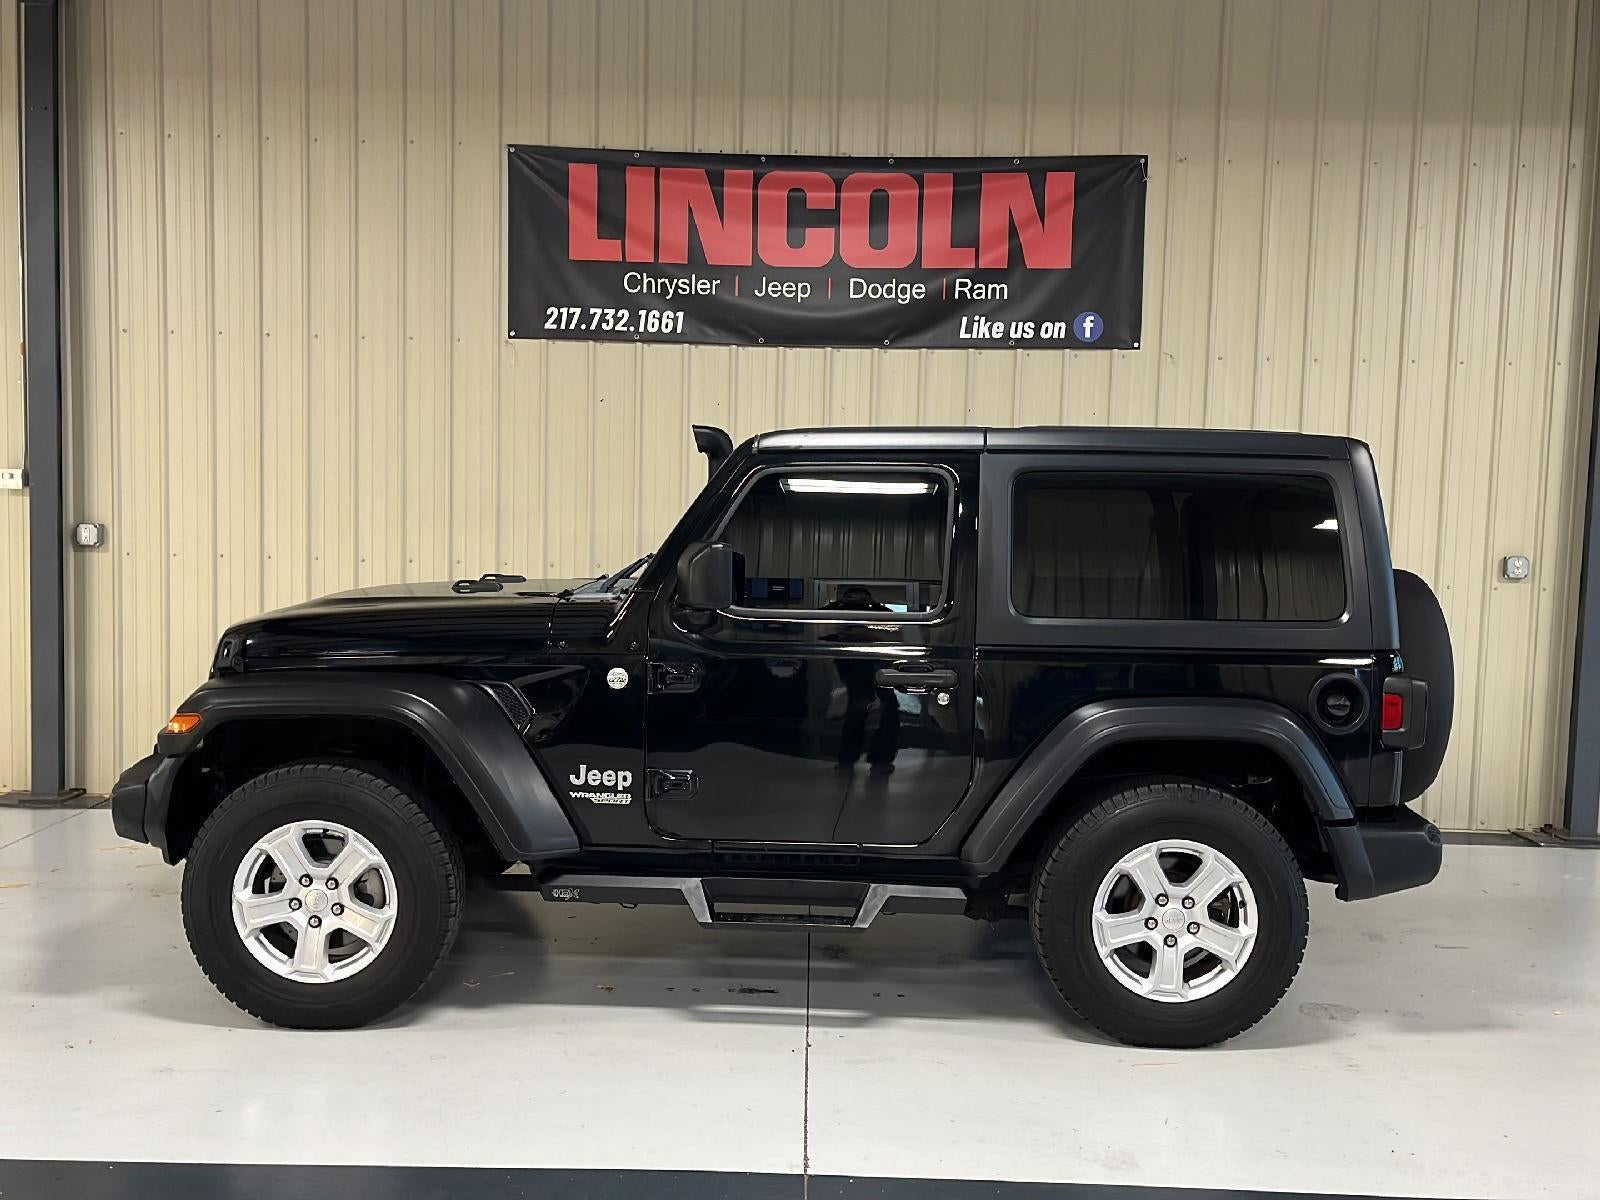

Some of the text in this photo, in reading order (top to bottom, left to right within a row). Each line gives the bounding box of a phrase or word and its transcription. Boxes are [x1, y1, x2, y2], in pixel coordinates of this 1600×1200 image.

[568, 163, 1075, 269] LINCOLN
[623, 271, 1008, 304] Chrysler Jeep Dodge Ram
[543, 306, 684, 333] 217.732.1661
[959, 315, 1004, 339] Like
[1009, 322, 1034, 339] us
[1040, 322, 1066, 339] on
[569, 764, 633, 791] Jeep
[569, 791, 632, 799] WRANGLER
